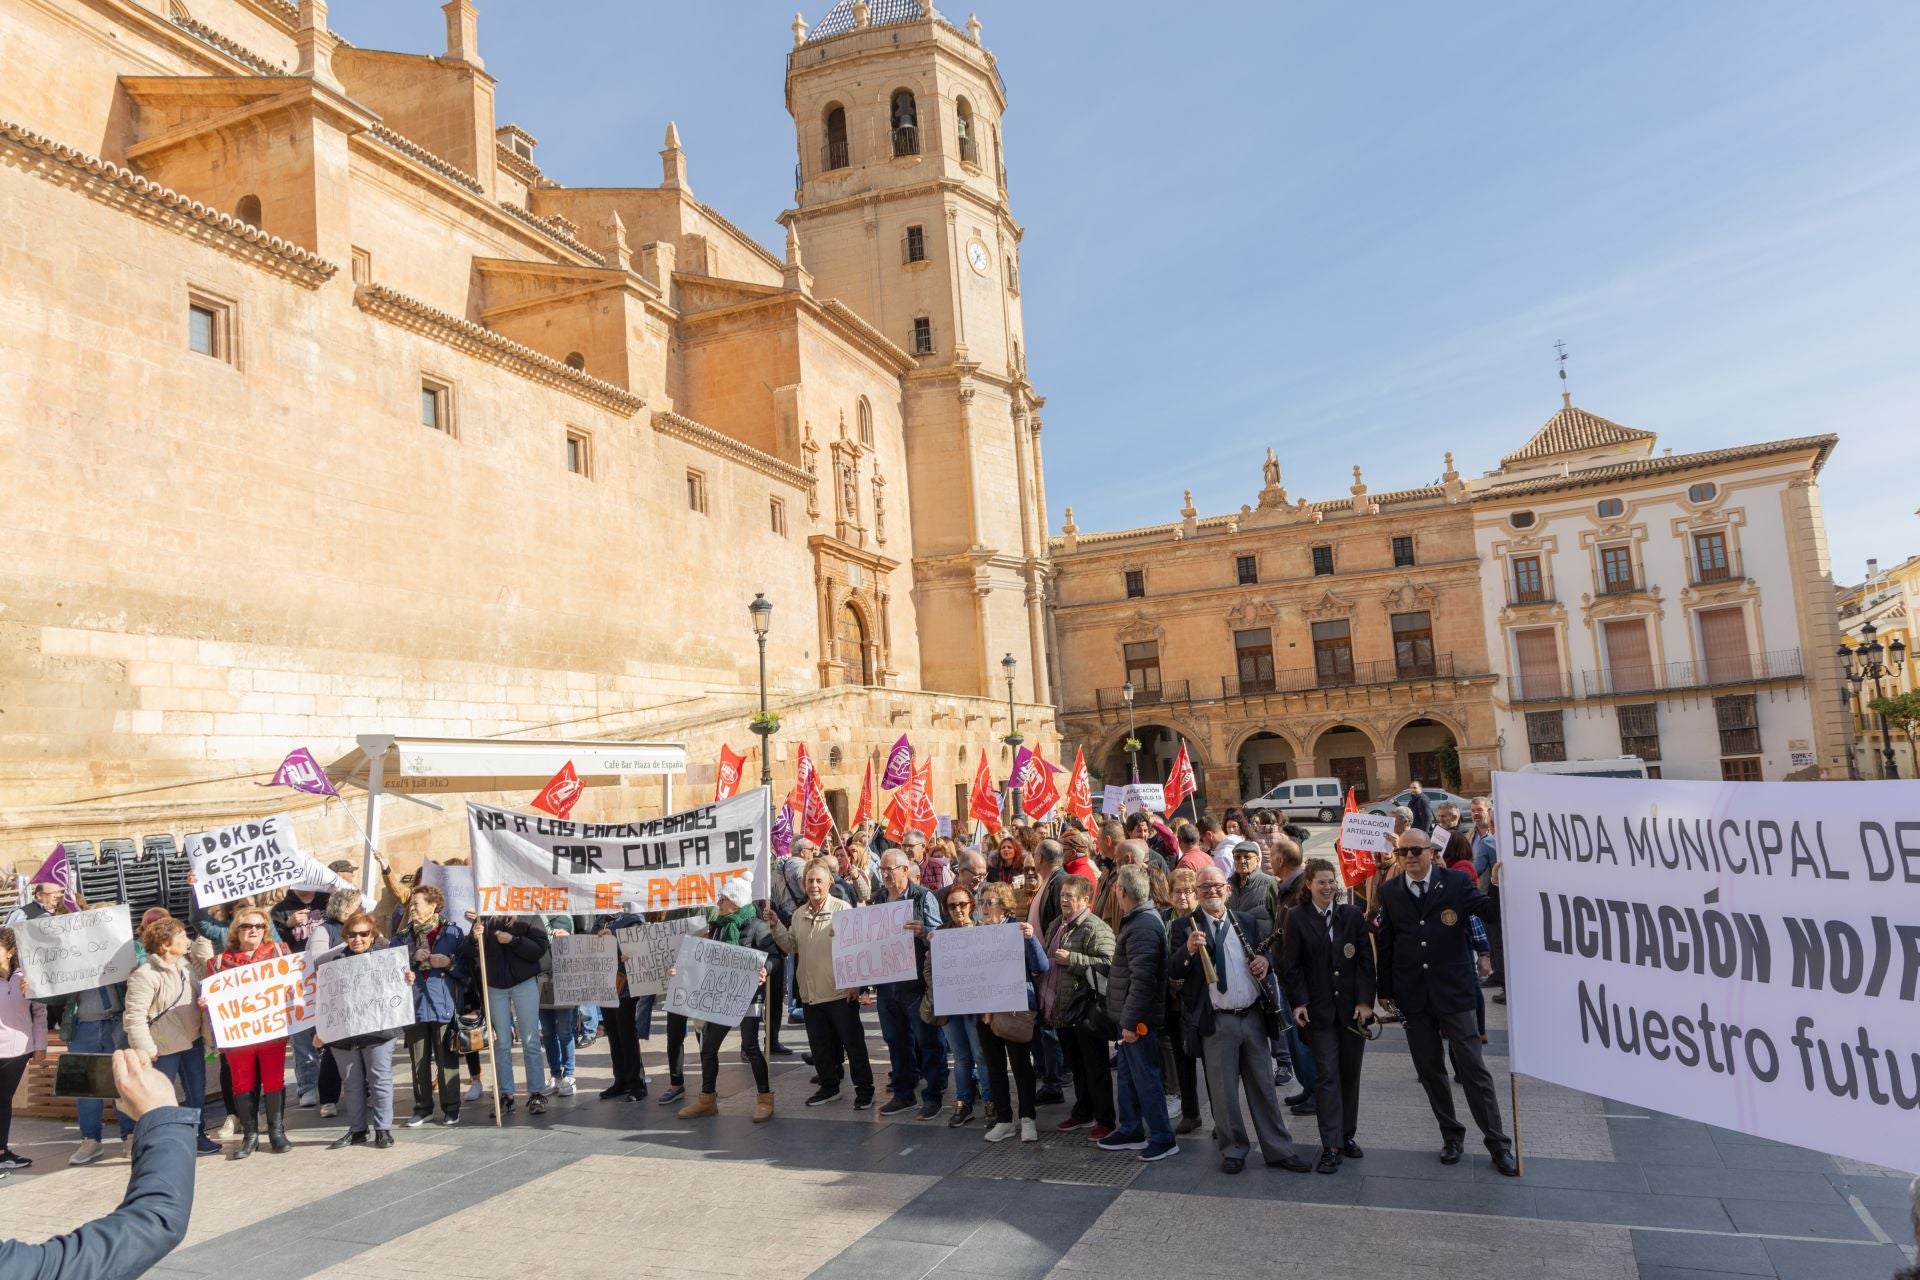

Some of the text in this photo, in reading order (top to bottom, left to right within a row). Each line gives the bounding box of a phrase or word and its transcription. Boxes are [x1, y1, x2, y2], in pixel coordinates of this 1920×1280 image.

[604, 760, 684, 771] Café Bar Plaza de España
[476, 810, 507, 831] NO
[514, 815, 529, 833] A
[536, 816, 576, 838] LAS
[552, 828, 755, 876] POR CULPA DE
[1510, 810, 1920, 882] BANDA MUNICIPAL DE
[203, 856, 296, 894] NUESTROS
[595, 882, 624, 910] DE
[38, 909, 113, 936] ESTAMOS
[618, 926, 634, 944] LA
[1538, 886, 1771, 984] LICITACIÓN
[88, 941, 108, 952] DE
[554, 936, 570, 956] NO
[208, 955, 307, 994] EXIGIMOS
[217, 972, 318, 1020] NUESTROS
[223, 1000, 316, 1042] IMPUESTOS
[1578, 980, 1920, 1111] Nuestro futu
